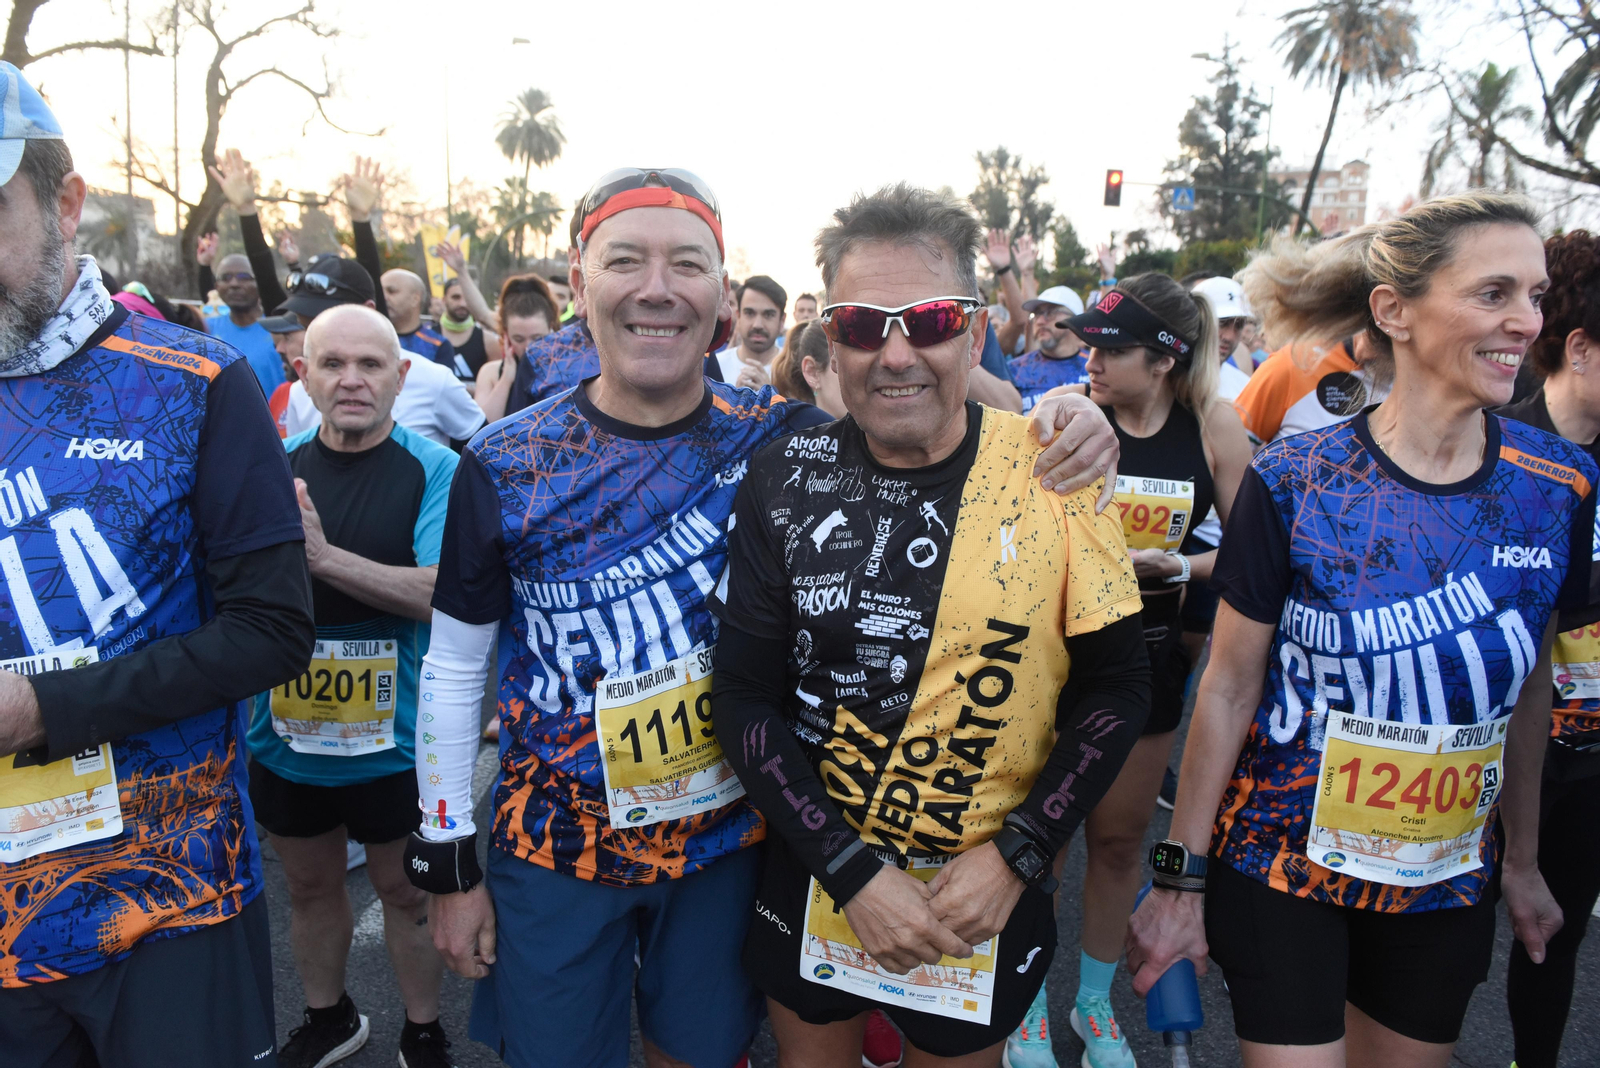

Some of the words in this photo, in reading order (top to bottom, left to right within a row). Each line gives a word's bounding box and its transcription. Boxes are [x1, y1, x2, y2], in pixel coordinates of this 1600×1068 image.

[64, 438, 144, 461] HOKA
[787, 435, 839, 454] AHORA
[798, 449, 837, 463] nunca
[1142, 479, 1177, 495] SEVILLA
[876, 487, 912, 508] MUERE
[585, 505, 721, 602] MARATÓN
[865, 515, 893, 577] RENDIRSE
[1492, 545, 1552, 569] HOKA
[802, 575, 815, 587] ES
[860, 590, 872, 600] EL
[873, 593, 902, 605] MURO
[858, 600, 876, 611] MIS
[877, 604, 922, 620] COJONES
[1279, 596, 1342, 654] MEDIO
[1350, 571, 1494, 653] MARATÓN
[342, 641, 380, 657] SEVILLA
[864, 648, 890, 659] SUEGRA
[856, 655, 889, 668] CORRE
[605, 680, 634, 700] MEDIO
[636, 665, 677, 693] MARATÓN
[830, 670, 868, 684] TIRADA
[835, 687, 869, 699] LARGA
[880, 692, 909, 710] RETO
[906, 617, 1030, 858] MARATÓN
[1341, 716, 1373, 738] MEDIO
[1376, 721, 1429, 746] MARATÓN
[1451, 722, 1495, 749] SEVILLA
[662, 739, 718, 766] SALVATIERRA
[671, 758, 696, 770] FRANCISCO
[695, 751, 713, 762] ANTONIO
[649, 765, 698, 784] SALVATIERRA
[1323, 771, 1335, 797] CAJÓN
[862, 735, 940, 852] MEDIO
[1338, 757, 1483, 815] 12403
[691, 792, 718, 807] HOKA
[1400, 815, 1427, 826] Cristi
[1370, 828, 1411, 842] Alconchel
[1395, 868, 1424, 878] HOKA
[878, 982, 905, 997] HOKA
